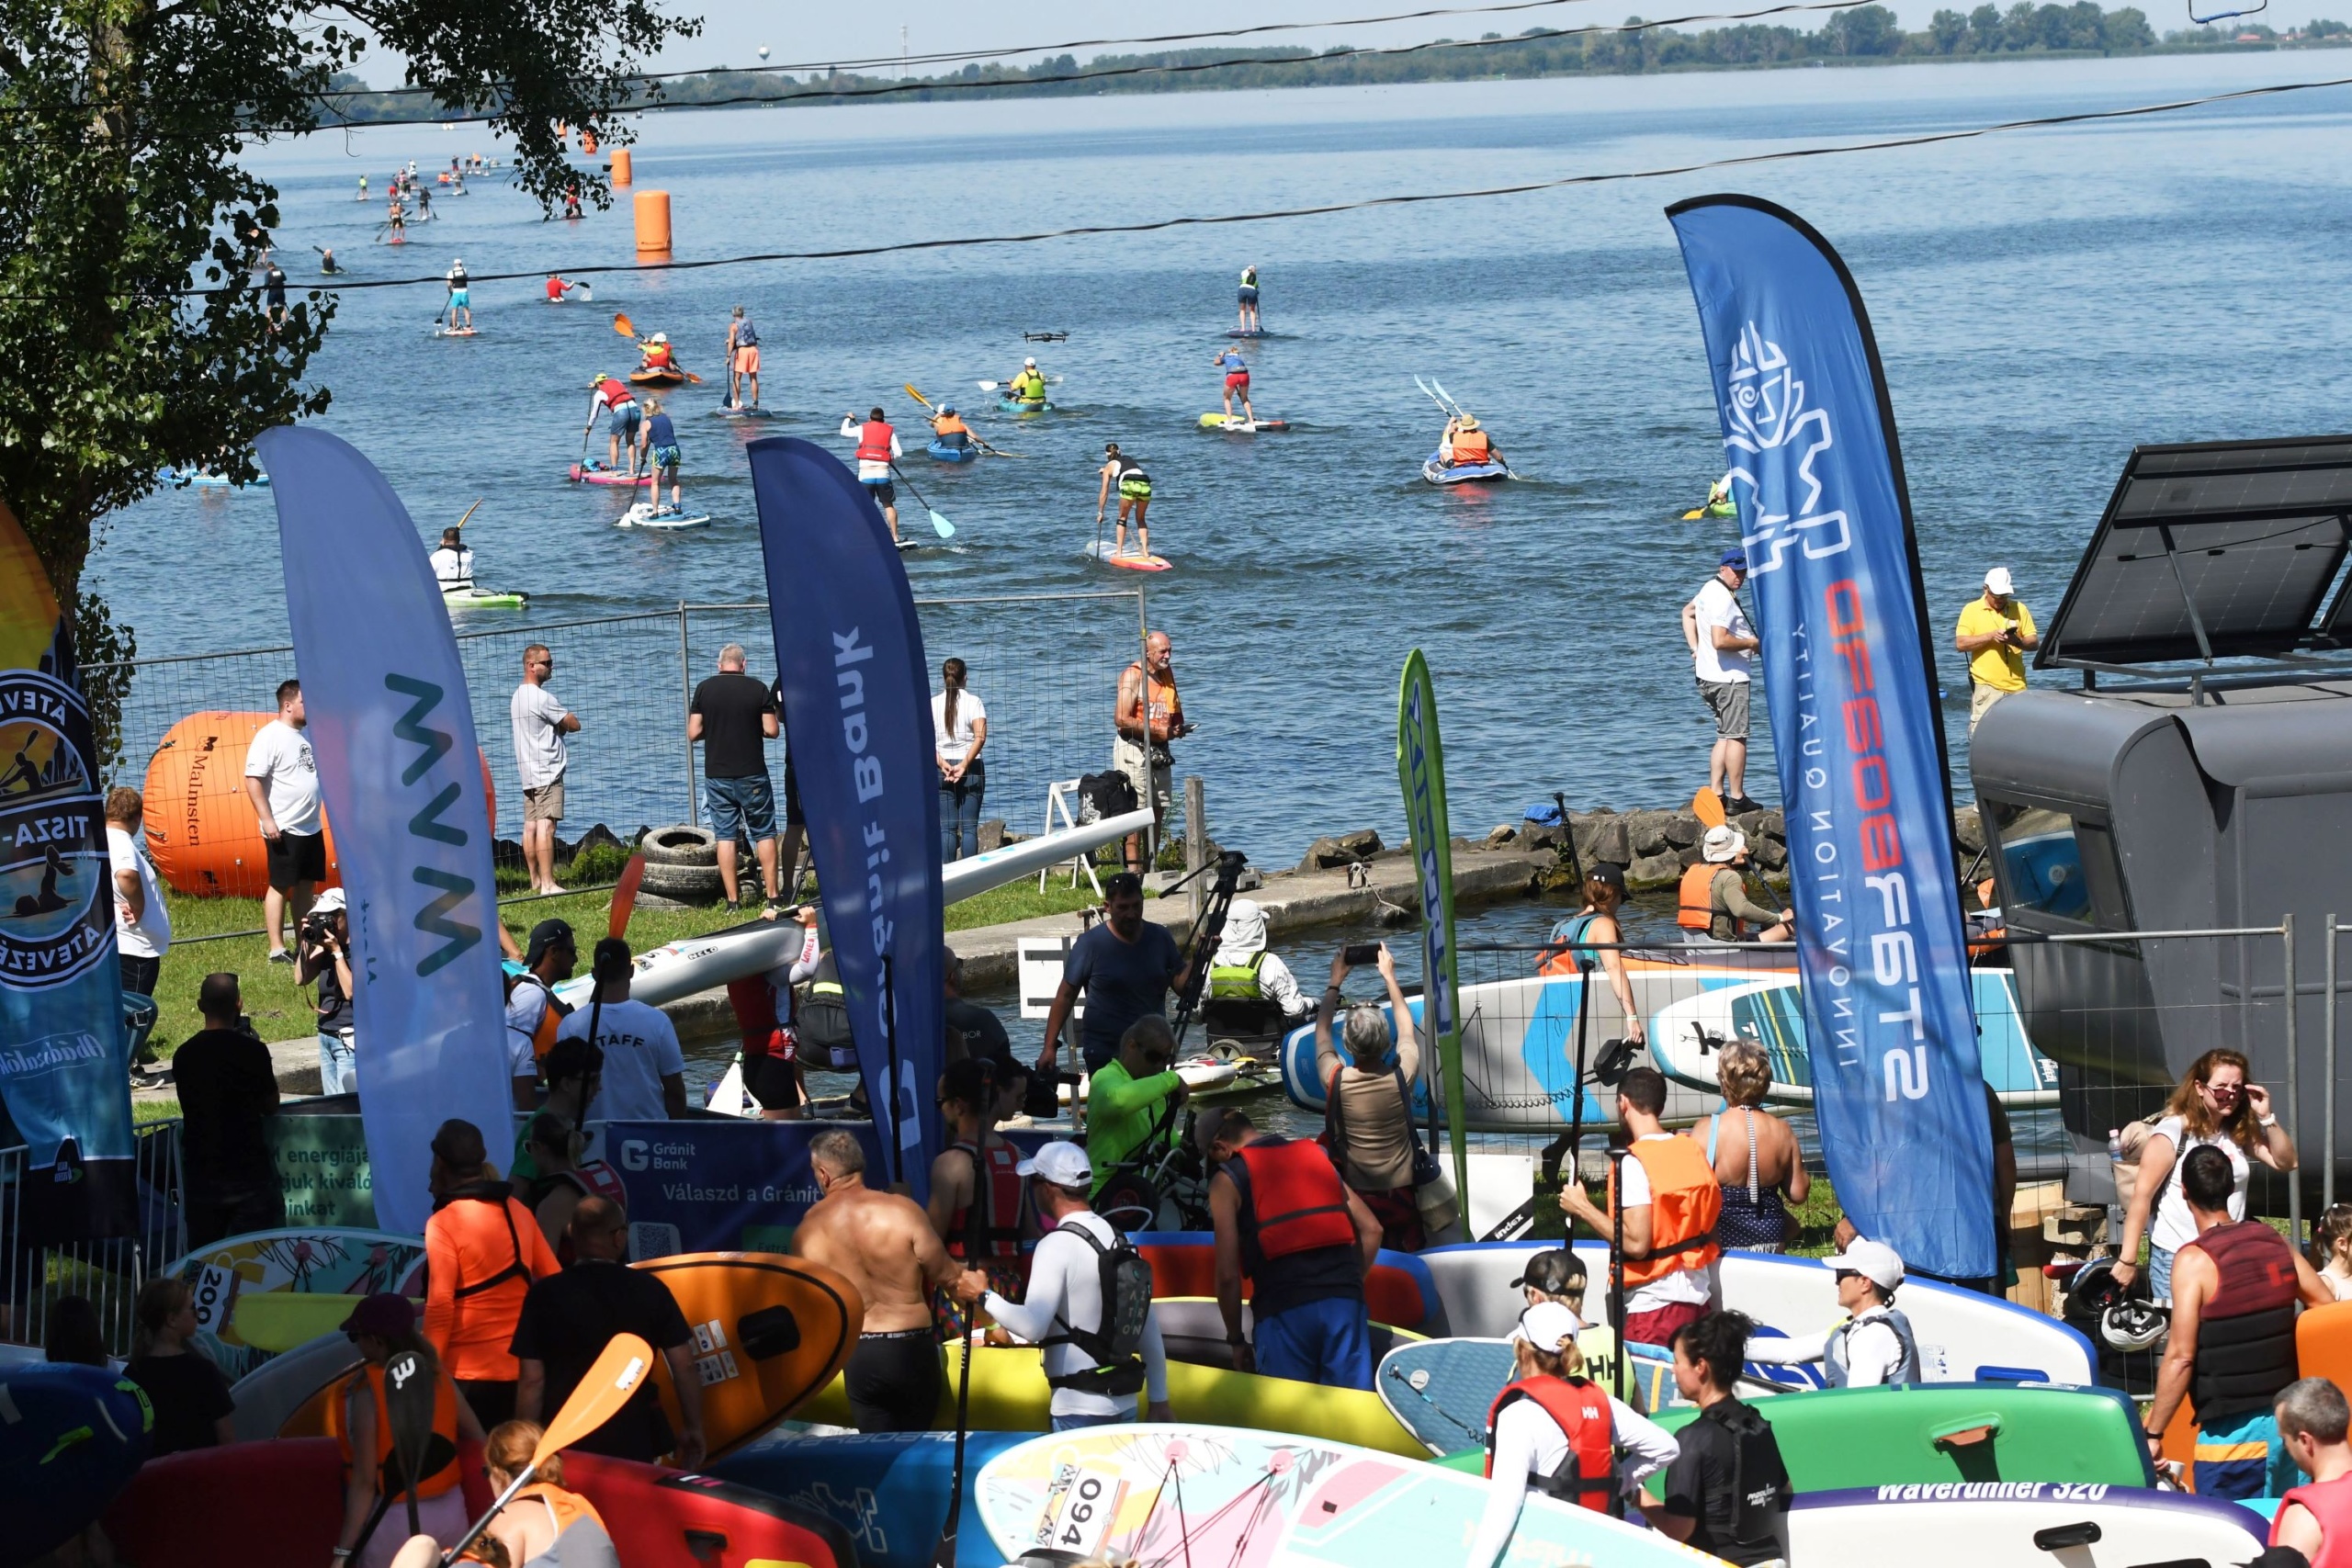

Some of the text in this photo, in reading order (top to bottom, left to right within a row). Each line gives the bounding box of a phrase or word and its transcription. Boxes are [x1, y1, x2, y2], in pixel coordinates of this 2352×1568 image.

[187, 755, 209, 847] Malmsten
[596, 1034, 645, 1048] TAFF
[653, 1142, 695, 1156] Gránit
[653, 1157, 687, 1169] Bank
[662, 1183, 739, 1201] Válaszd
[747, 1190, 756, 1201] a
[286, 1198, 336, 1216] inkat
[1494, 1213, 1524, 1239] index
[1582, 1407, 1599, 1419] HH
[1061, 1478, 1102, 1545] 094
